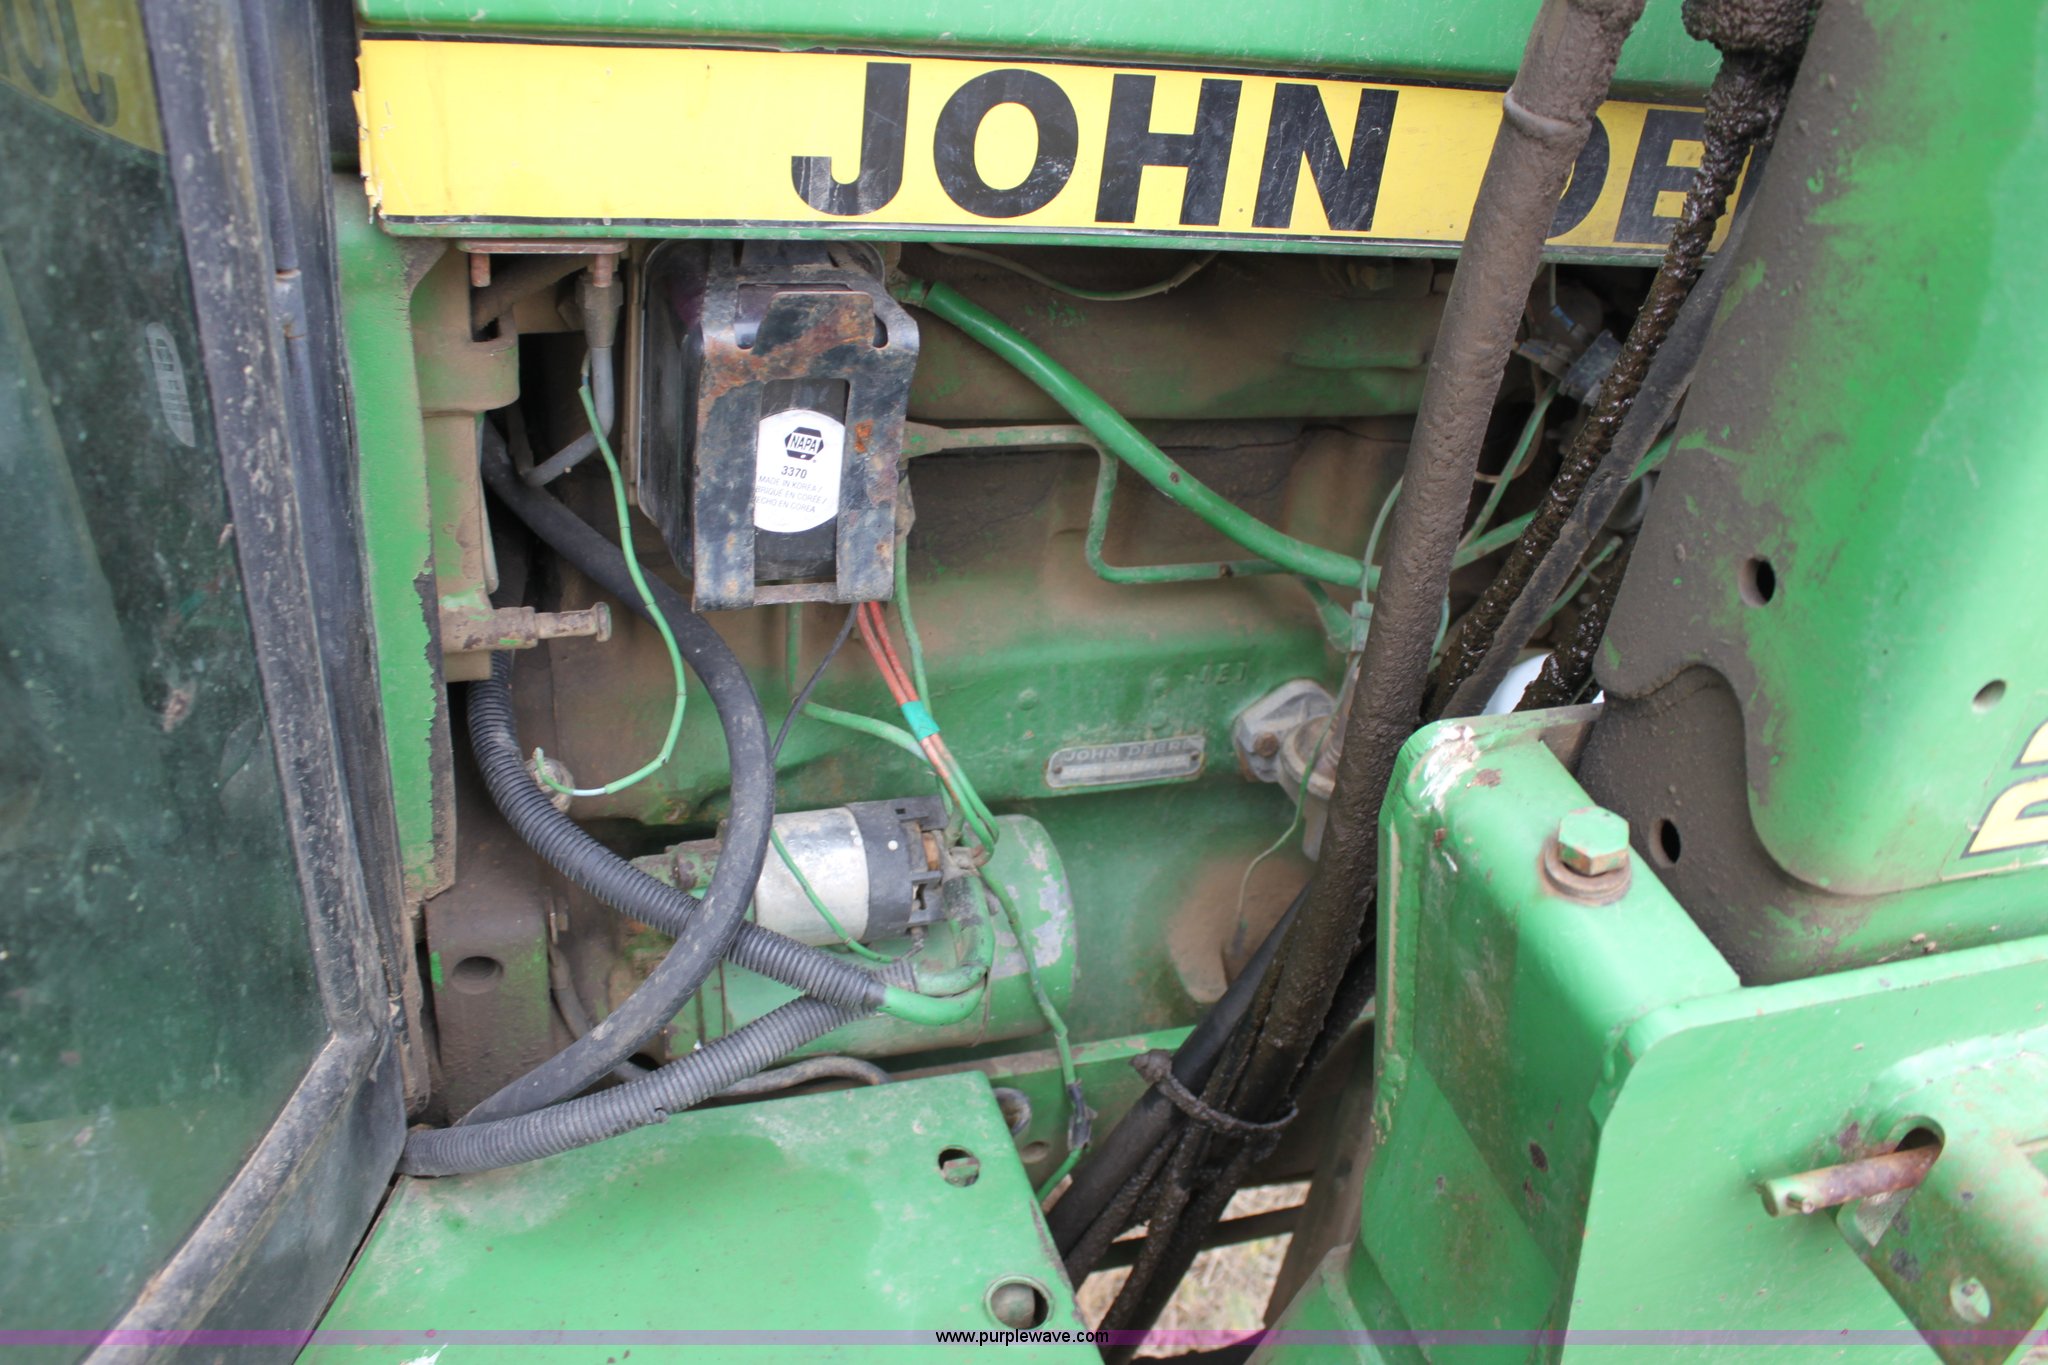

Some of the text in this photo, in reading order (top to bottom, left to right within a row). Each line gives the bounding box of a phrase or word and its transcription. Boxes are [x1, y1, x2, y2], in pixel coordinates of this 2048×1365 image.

[790, 61, 1399, 233] JOHN
[790, 434, 818, 453] NAPA
[781, 465, 808, 479] 3370
[758, 475, 780, 486] MADE
[782, 479, 790, 487] IN
[792, 480, 817, 492] KOREA
[785, 489, 796, 499] EN
[1064, 748, 1120, 762] JOHN
